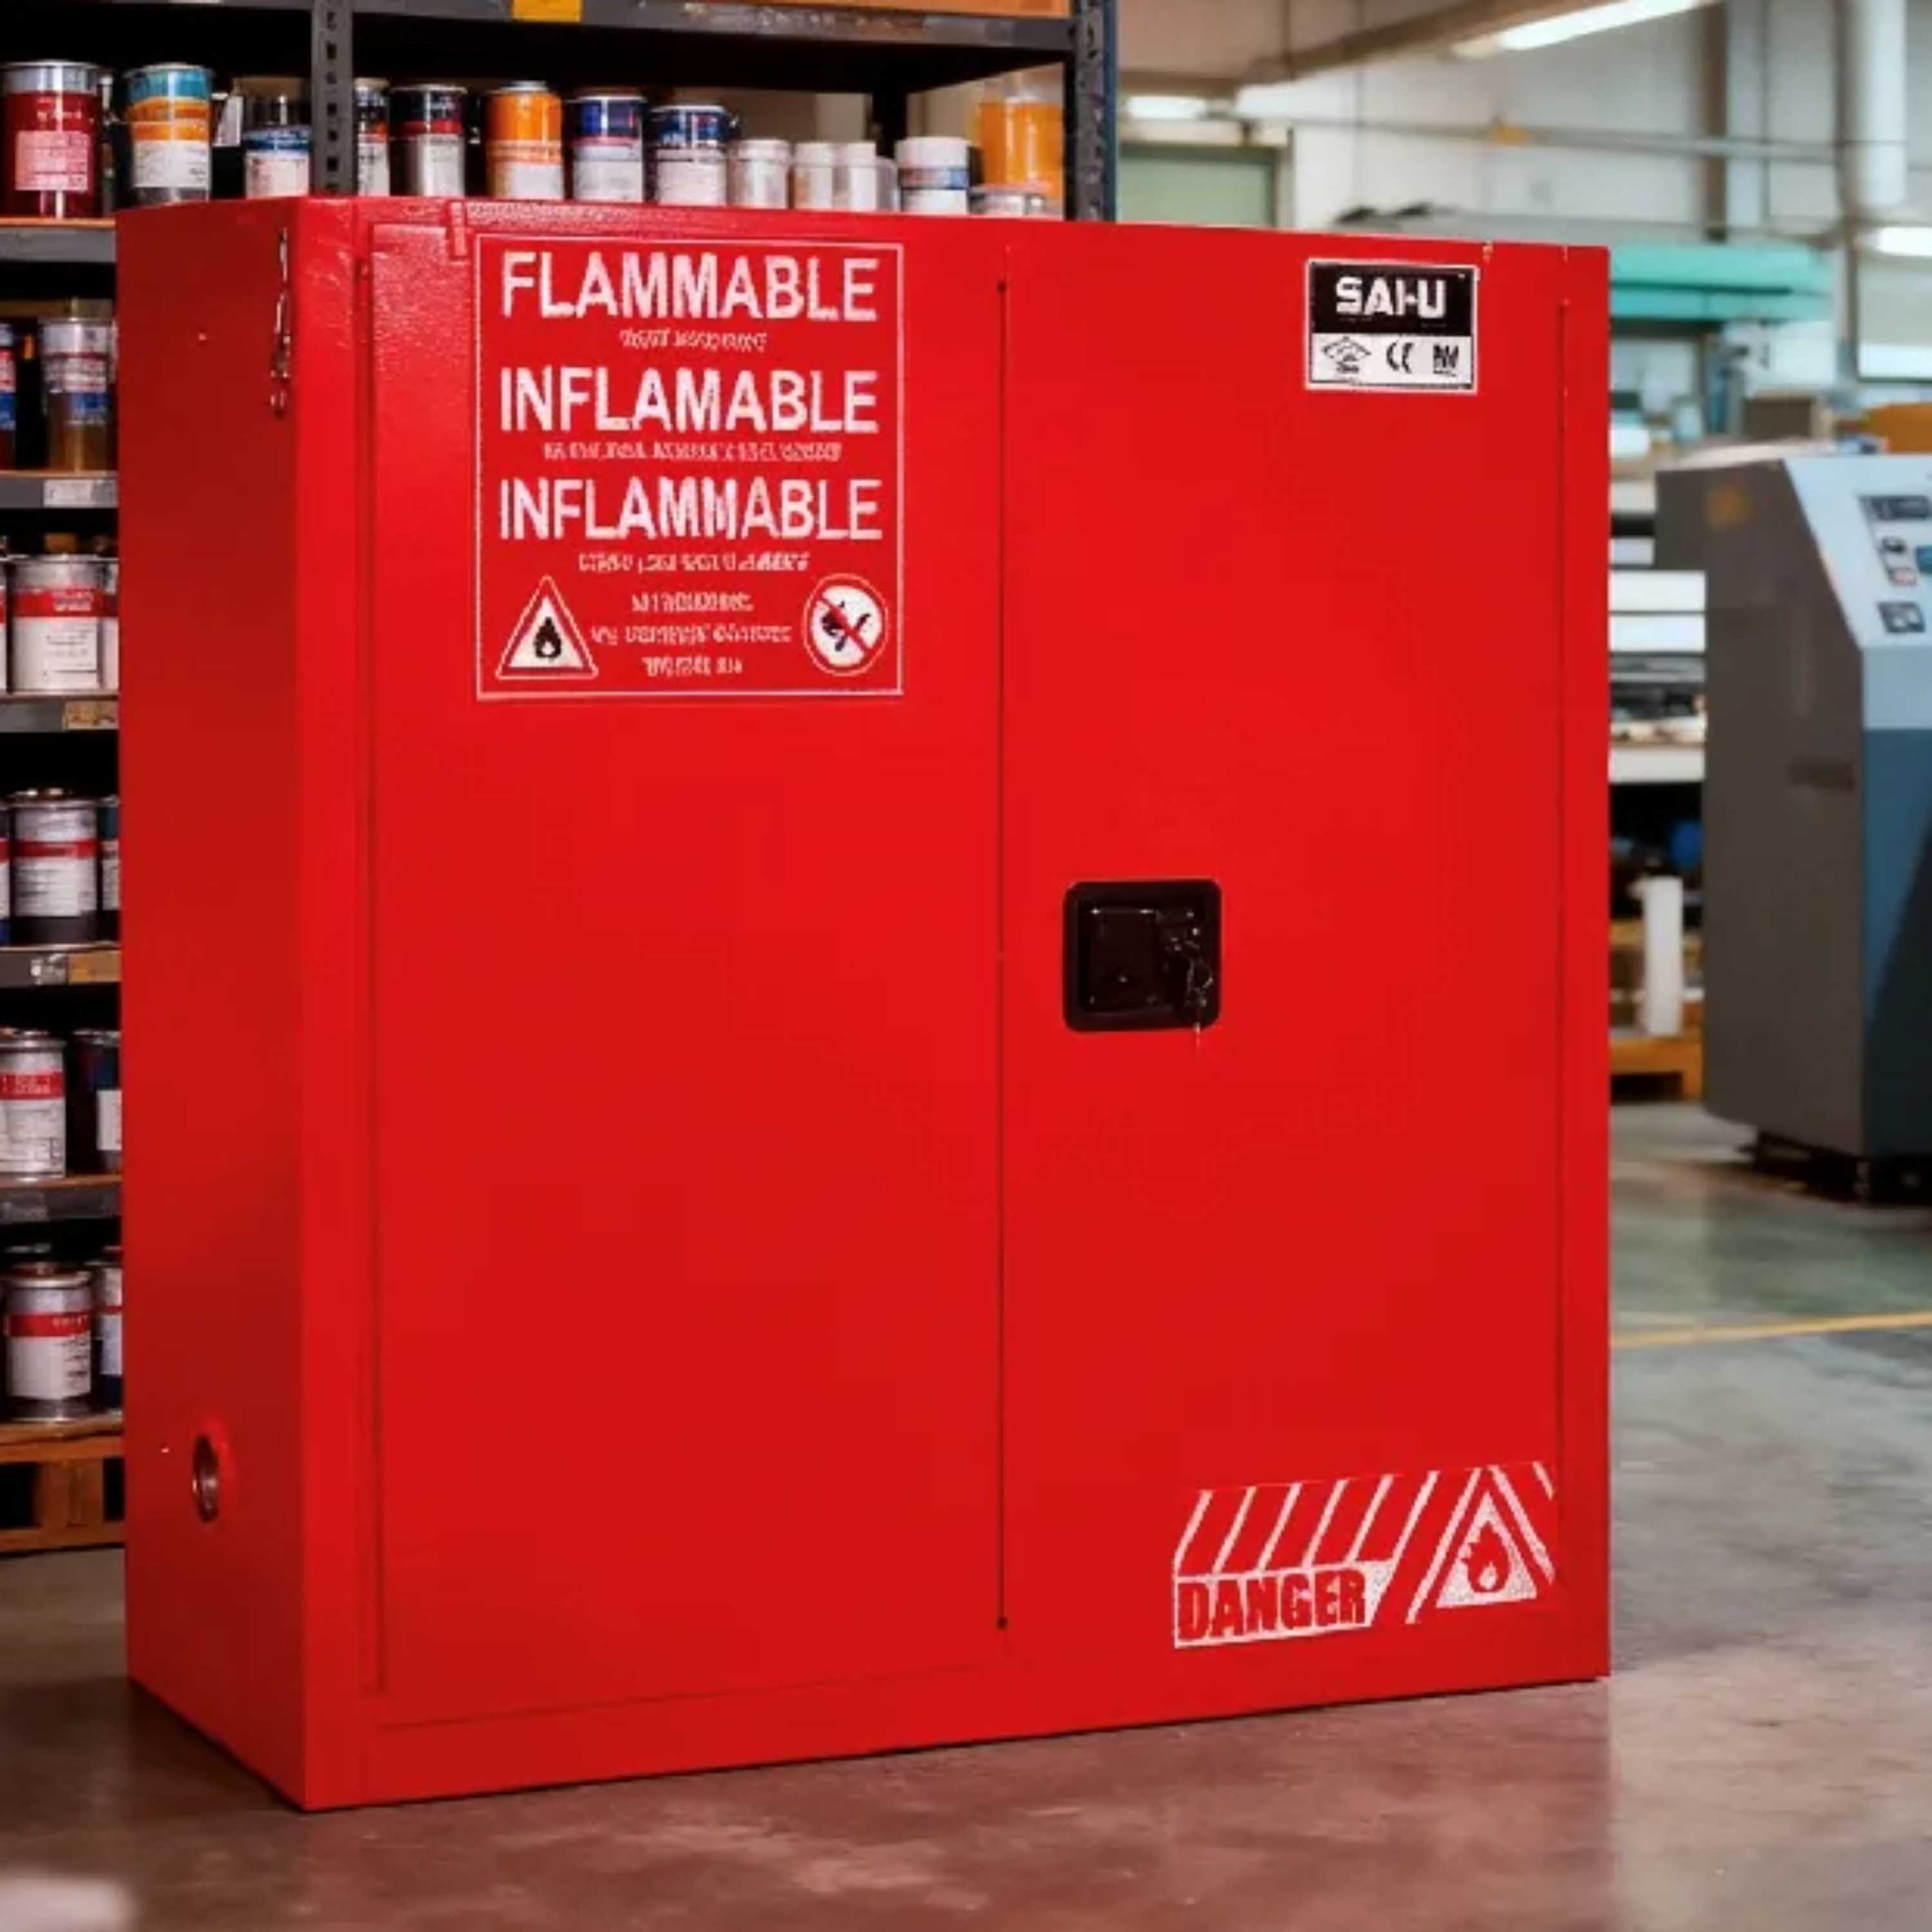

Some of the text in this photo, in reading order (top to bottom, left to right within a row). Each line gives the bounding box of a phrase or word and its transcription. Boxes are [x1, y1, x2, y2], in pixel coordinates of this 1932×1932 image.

[501, 251, 880, 322] FLAMMABLE
[500, 366, 880, 434] INFLAMABLE
[500, 476, 884, 540] INFLAMMABLE
[1177, 1566, 1367, 1641] DANGER
